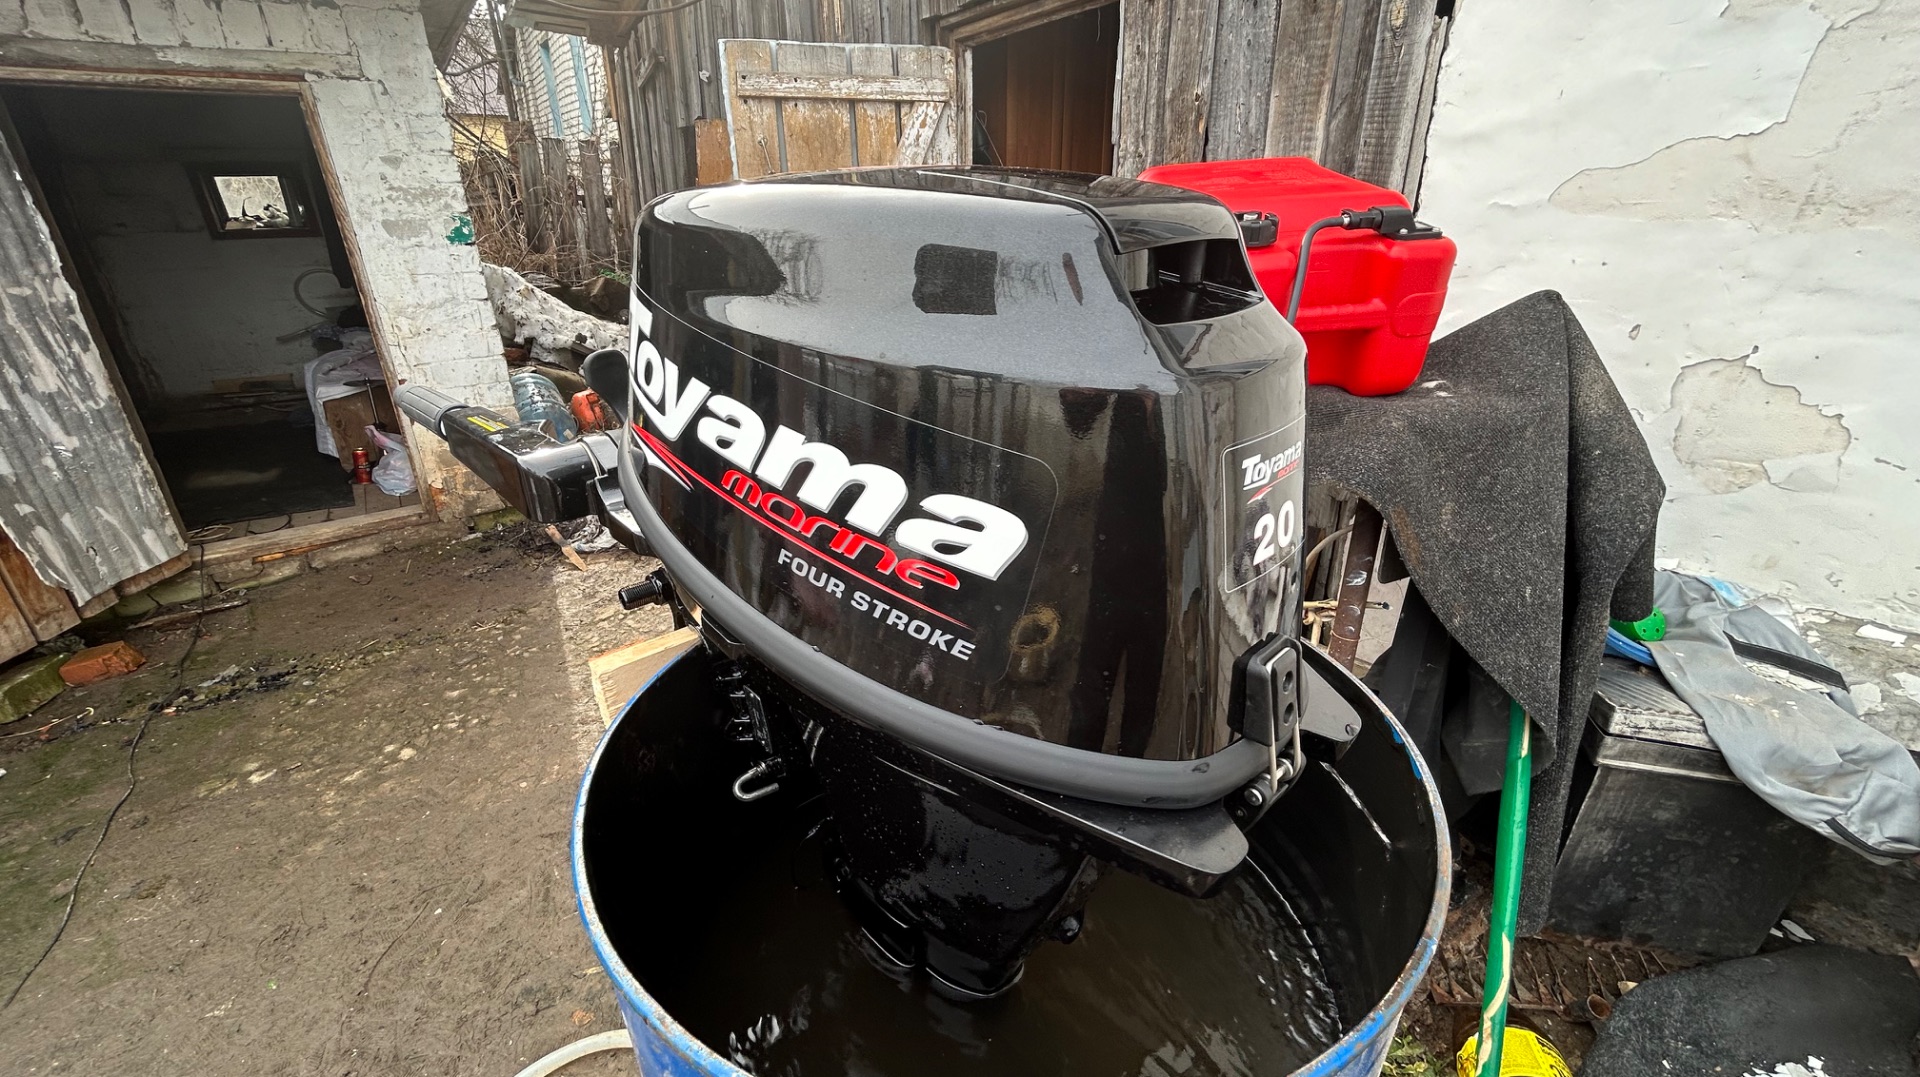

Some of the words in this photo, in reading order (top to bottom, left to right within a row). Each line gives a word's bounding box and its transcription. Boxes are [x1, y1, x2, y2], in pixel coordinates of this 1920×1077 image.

[629, 287, 1029, 581] Toyama
[1241, 440, 1302, 490] Toyama
[720, 469, 960, 590] marine
[1253, 500, 1295, 566] 20
[777, 547, 846, 599] FOUR
[850, 591, 977, 661] STROKE
